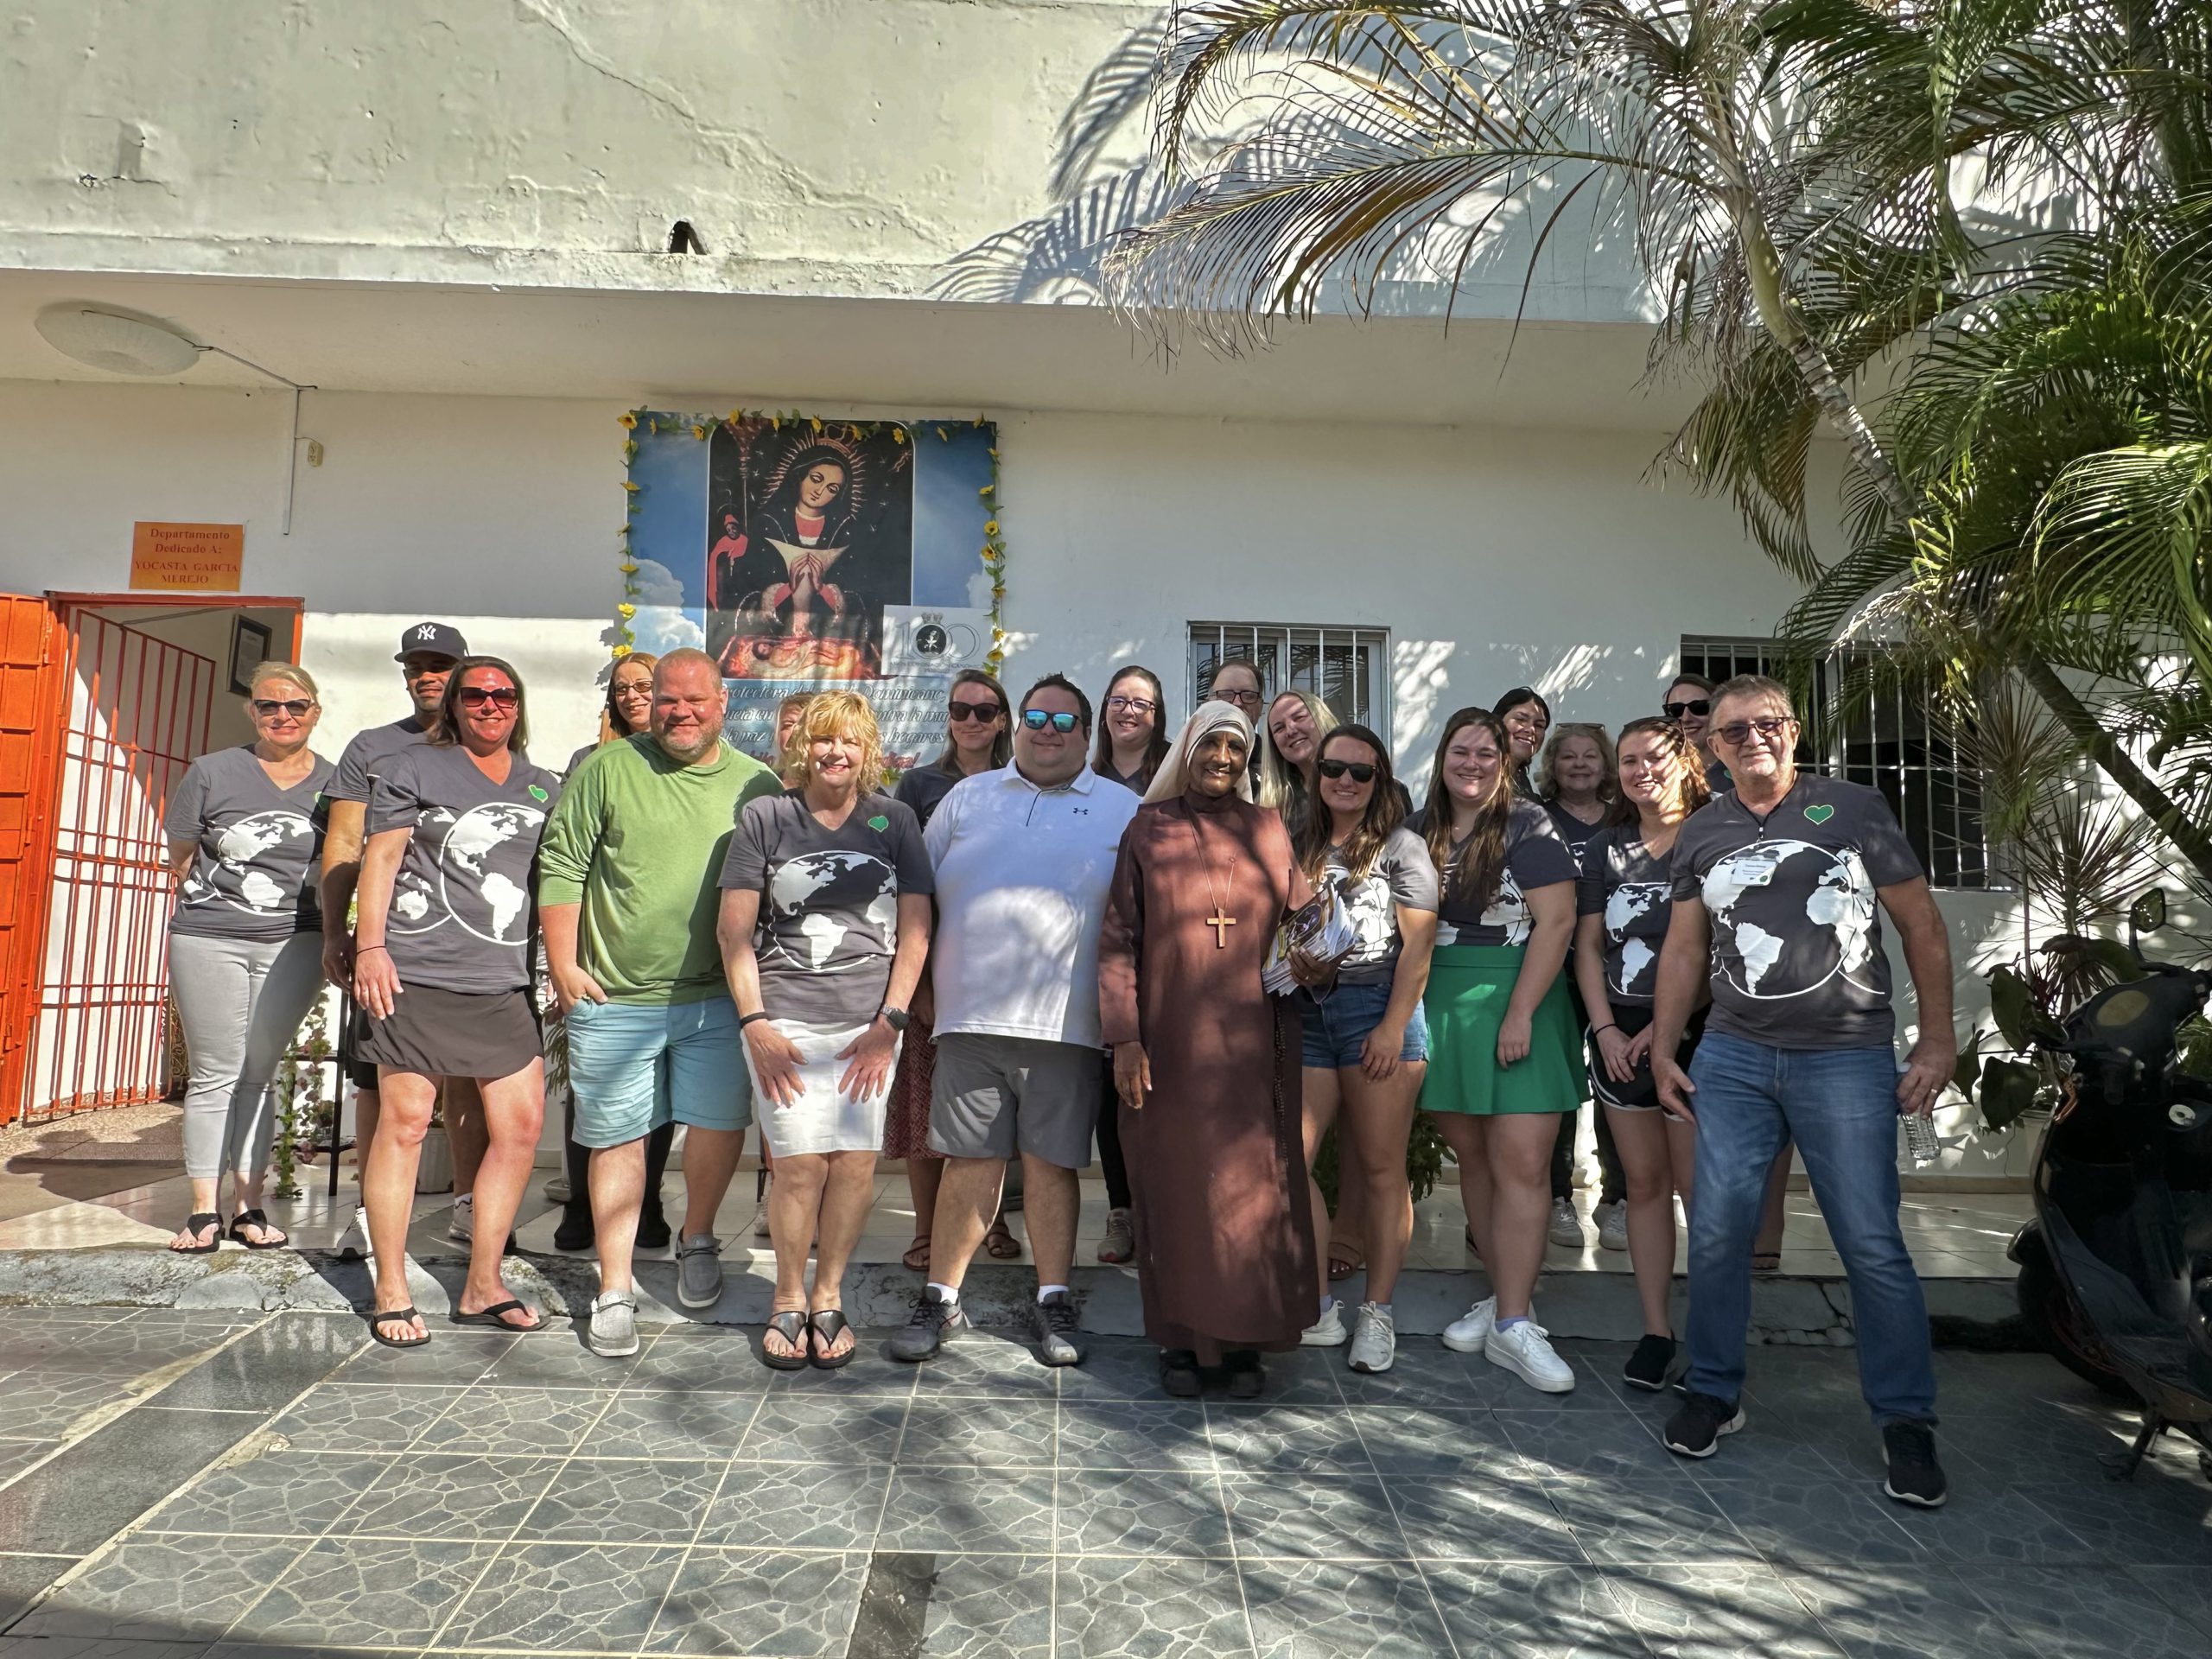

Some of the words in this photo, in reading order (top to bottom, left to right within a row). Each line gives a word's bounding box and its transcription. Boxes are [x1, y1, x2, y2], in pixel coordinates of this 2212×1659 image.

[150, 528, 230, 541] Departamento
[155, 543, 207, 554] Dedicado
[209, 545, 222, 554] A:
[135, 561, 188, 571] YOCASTA
[162, 575, 208, 584] MEREJO
[417, 625, 436, 640] NY
[727, 684, 790, 699] rotectora
